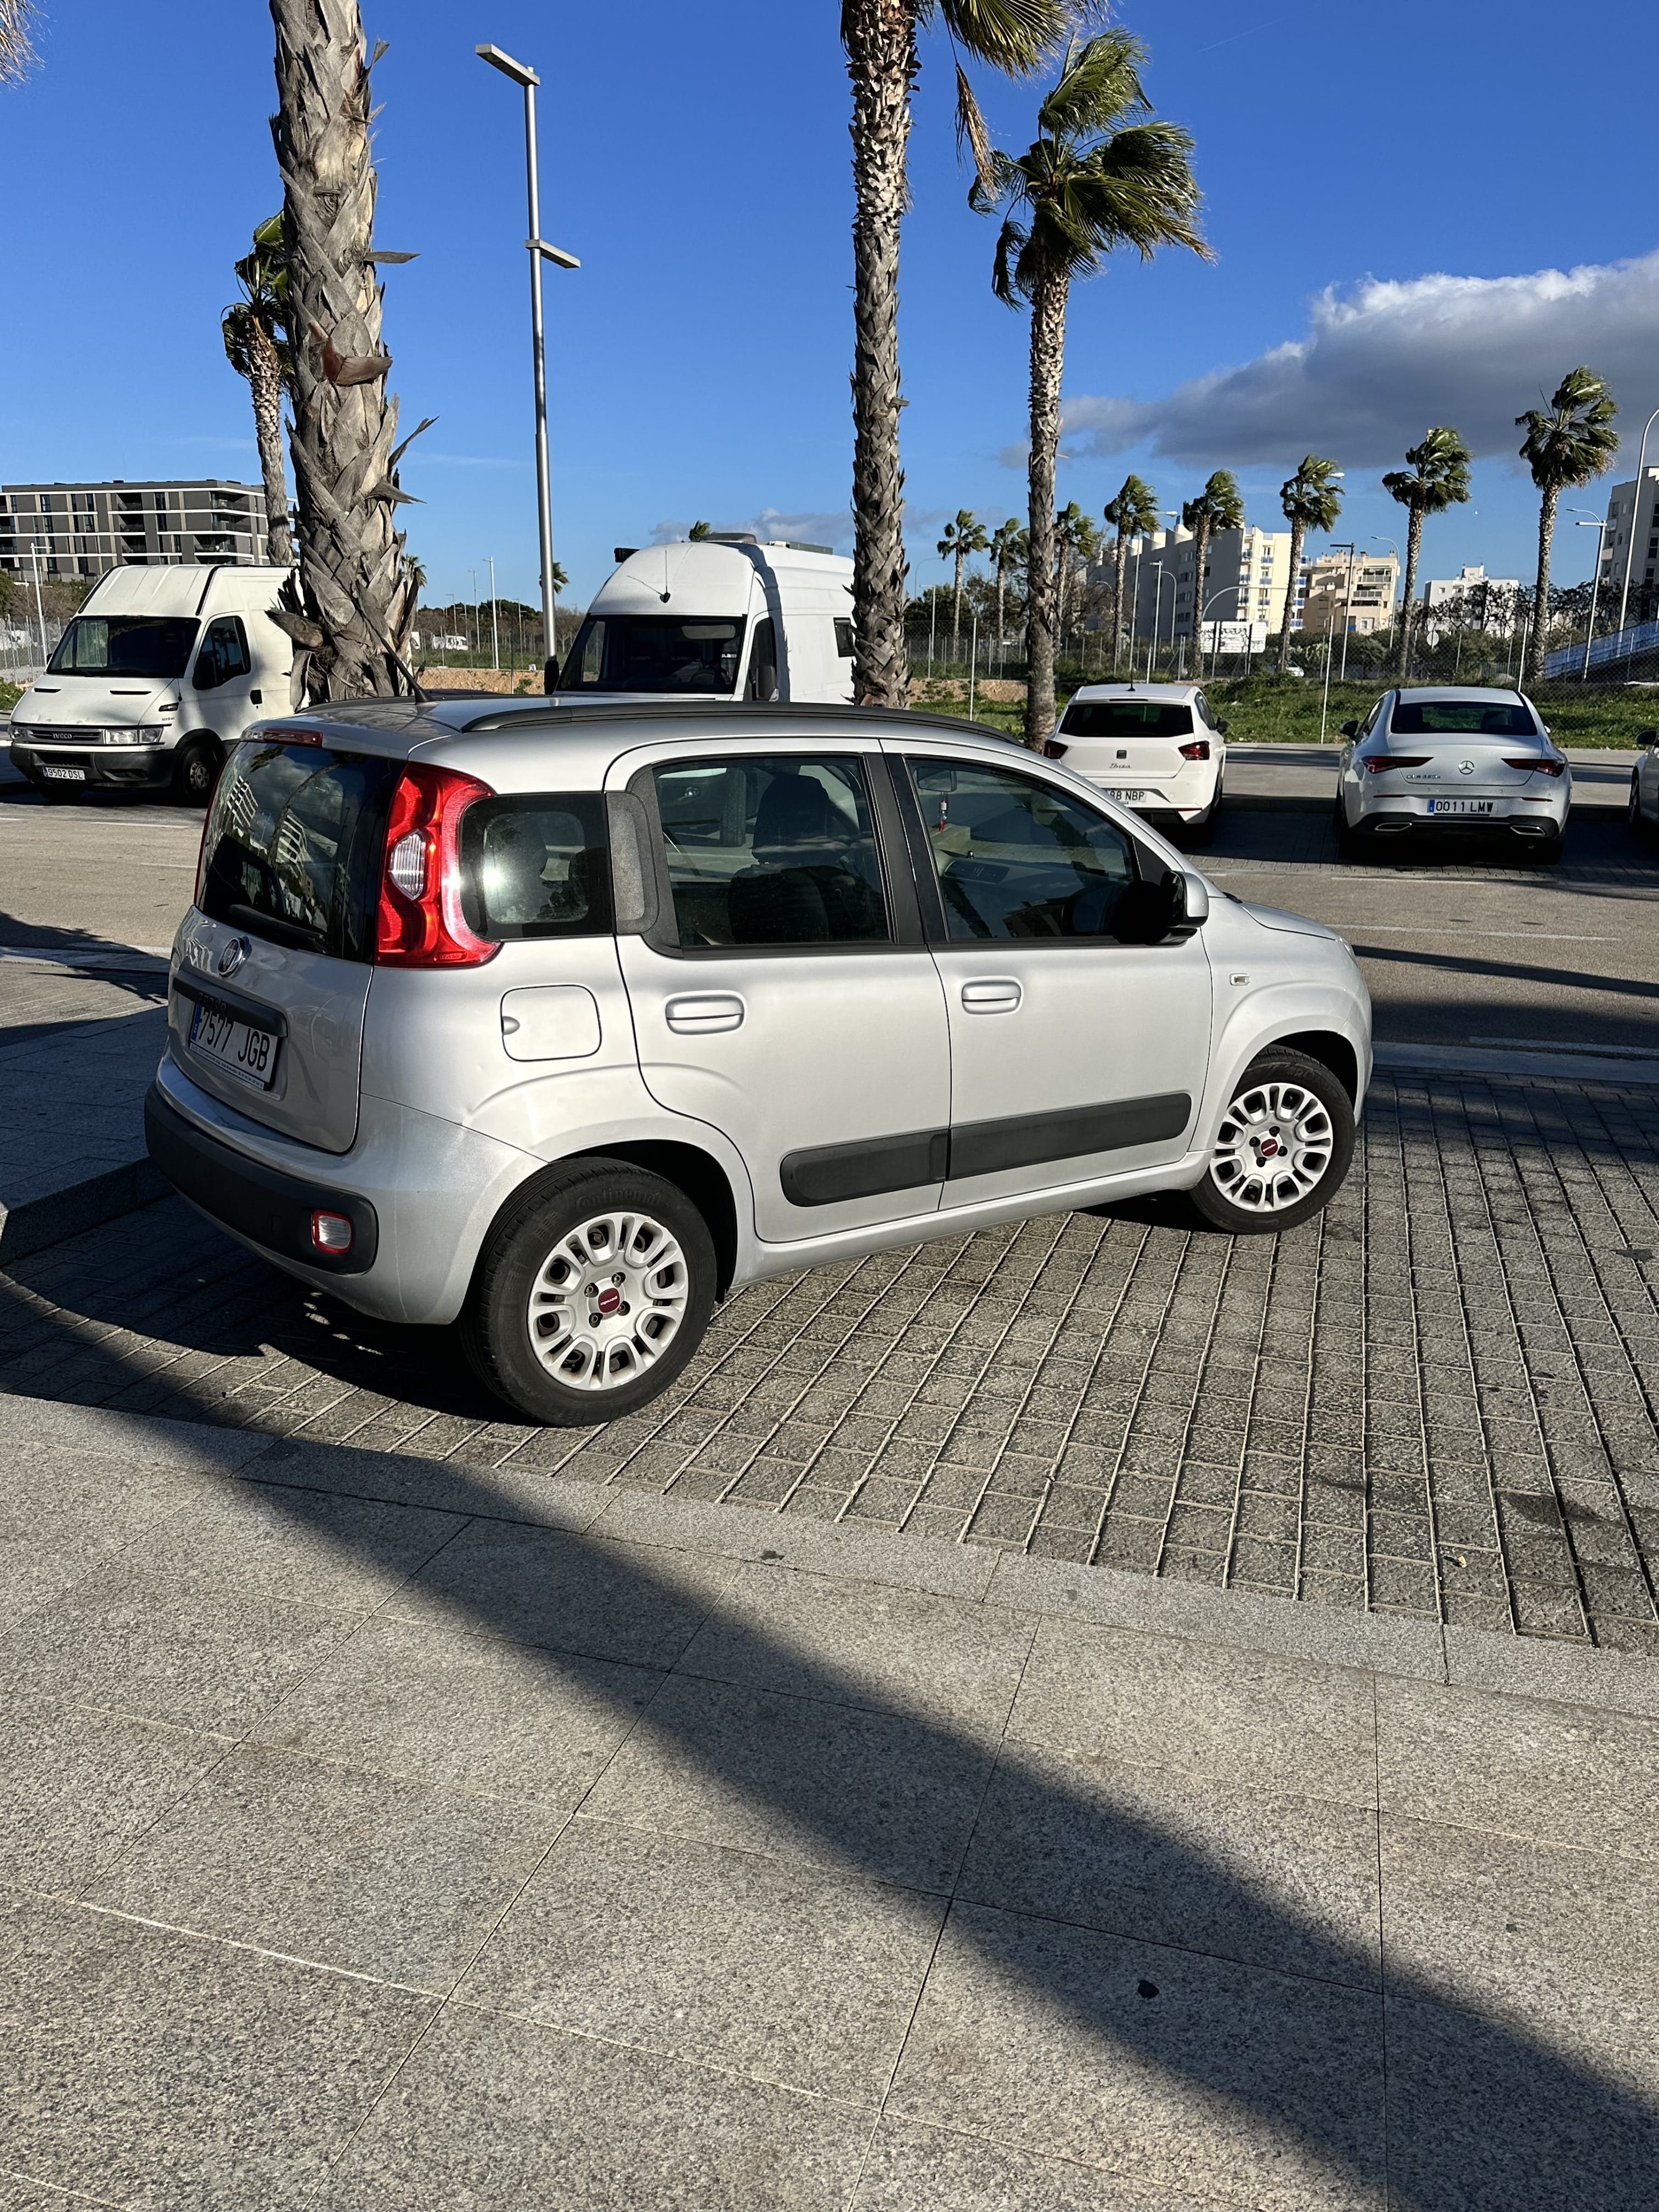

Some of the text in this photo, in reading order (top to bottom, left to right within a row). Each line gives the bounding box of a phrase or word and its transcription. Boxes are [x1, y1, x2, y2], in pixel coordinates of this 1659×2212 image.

[48, 768, 83, 779] 9502 DSL
[1125, 791, 1145, 801] NBP
[1436, 801, 1493, 812] 0011 LMW
[199, 1010, 234, 1053] 7577
[238, 1028, 270, 1072] JGB
[575, 1187, 662, 1211] Continental
